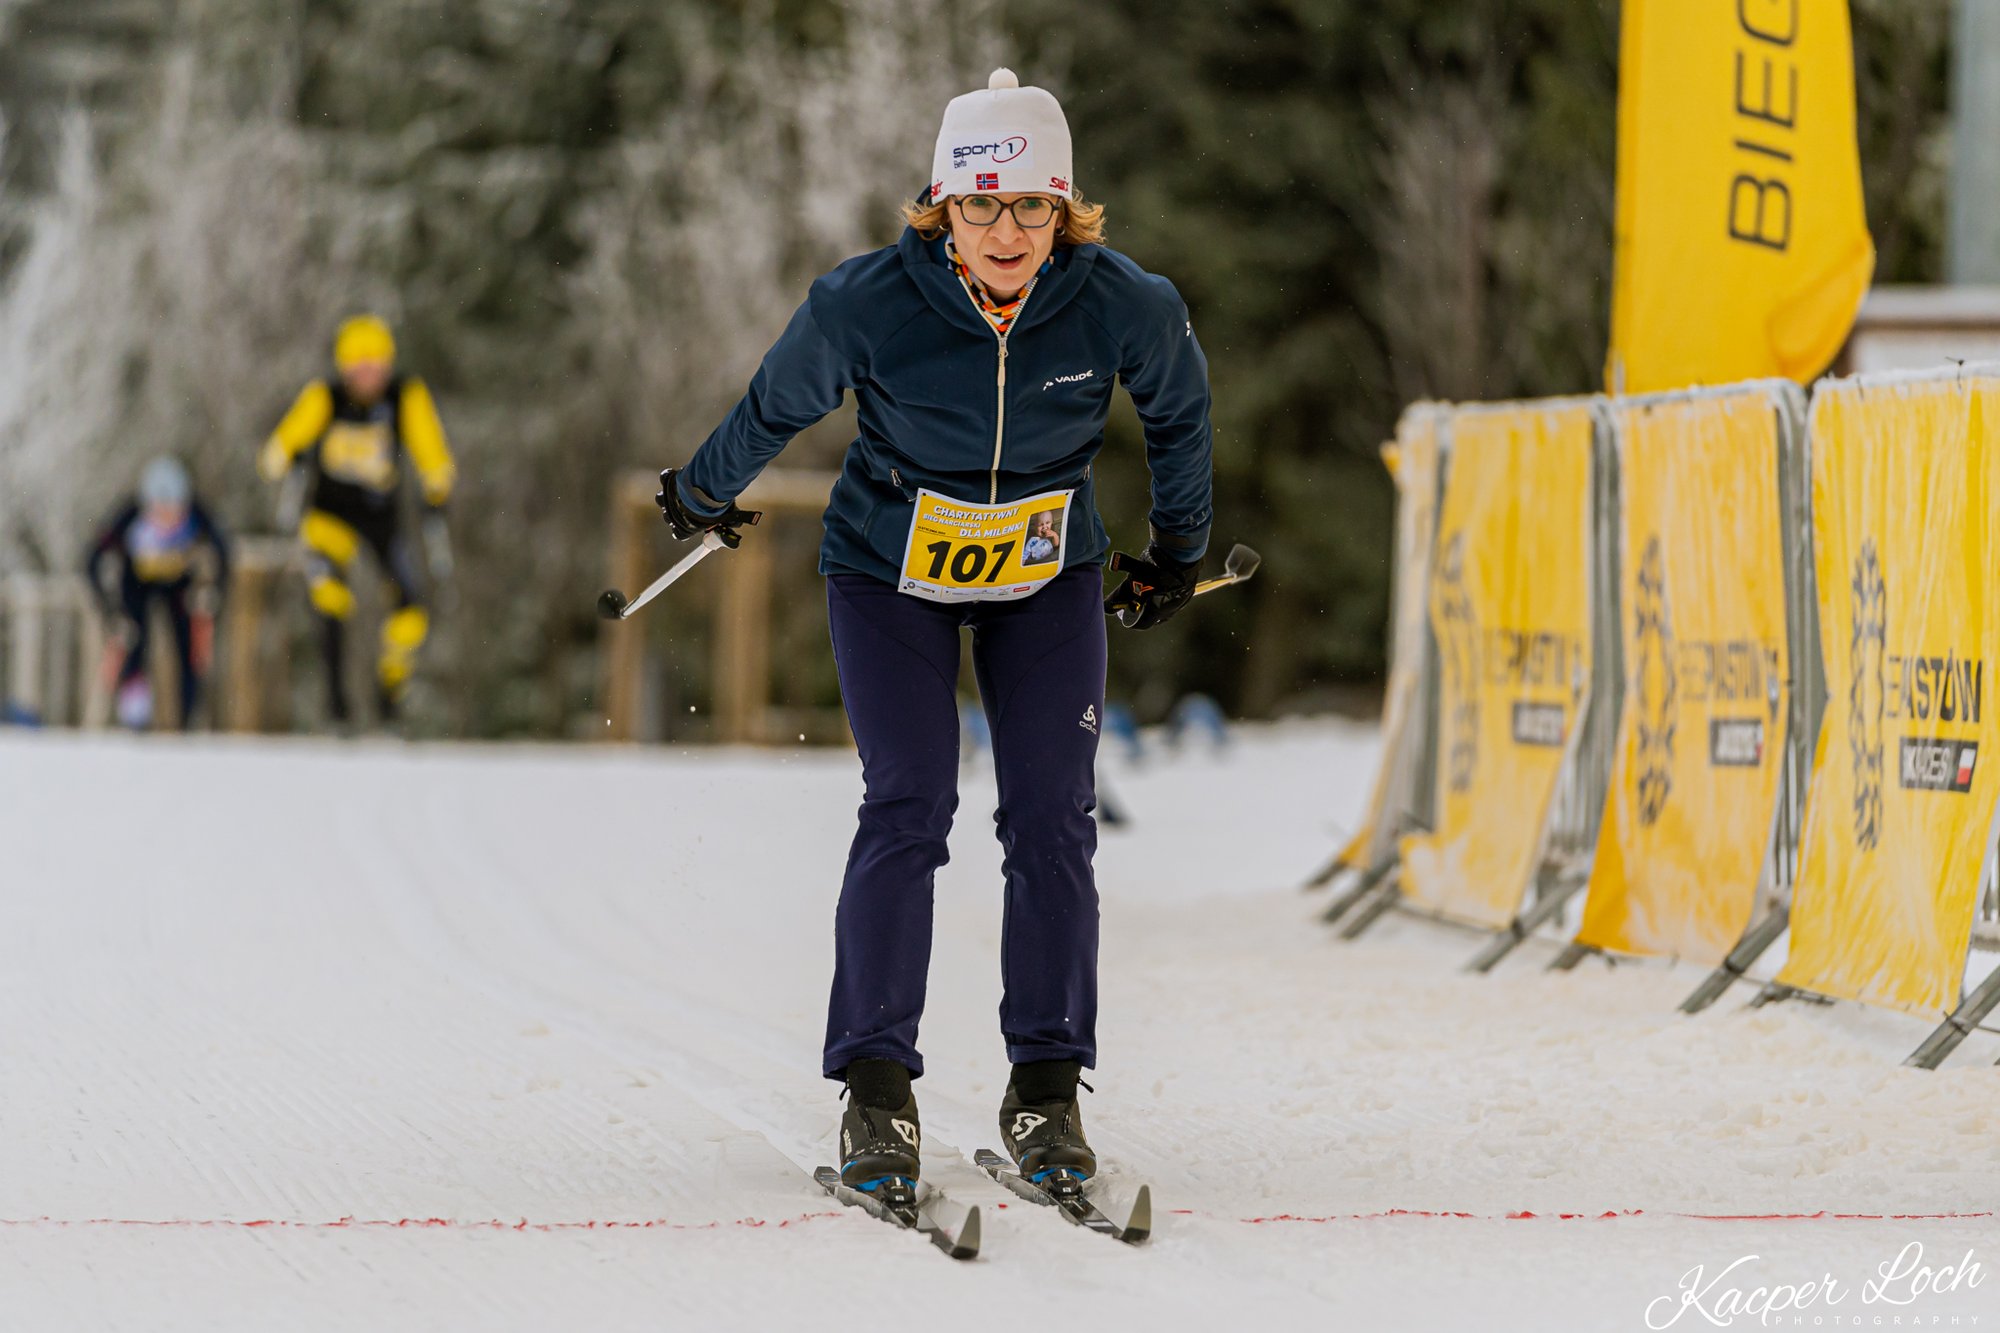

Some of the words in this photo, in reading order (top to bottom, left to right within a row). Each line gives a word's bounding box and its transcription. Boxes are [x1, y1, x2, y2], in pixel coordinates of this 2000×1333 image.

[953, 142, 1000, 159] sport
[1055, 369, 1093, 383] VAUDE
[933, 505, 1021, 521] CHARYTATYWNY
[959, 528, 982, 538] DLA
[984, 521, 1024, 538] MILENKI
[926, 540, 1017, 584] 107
